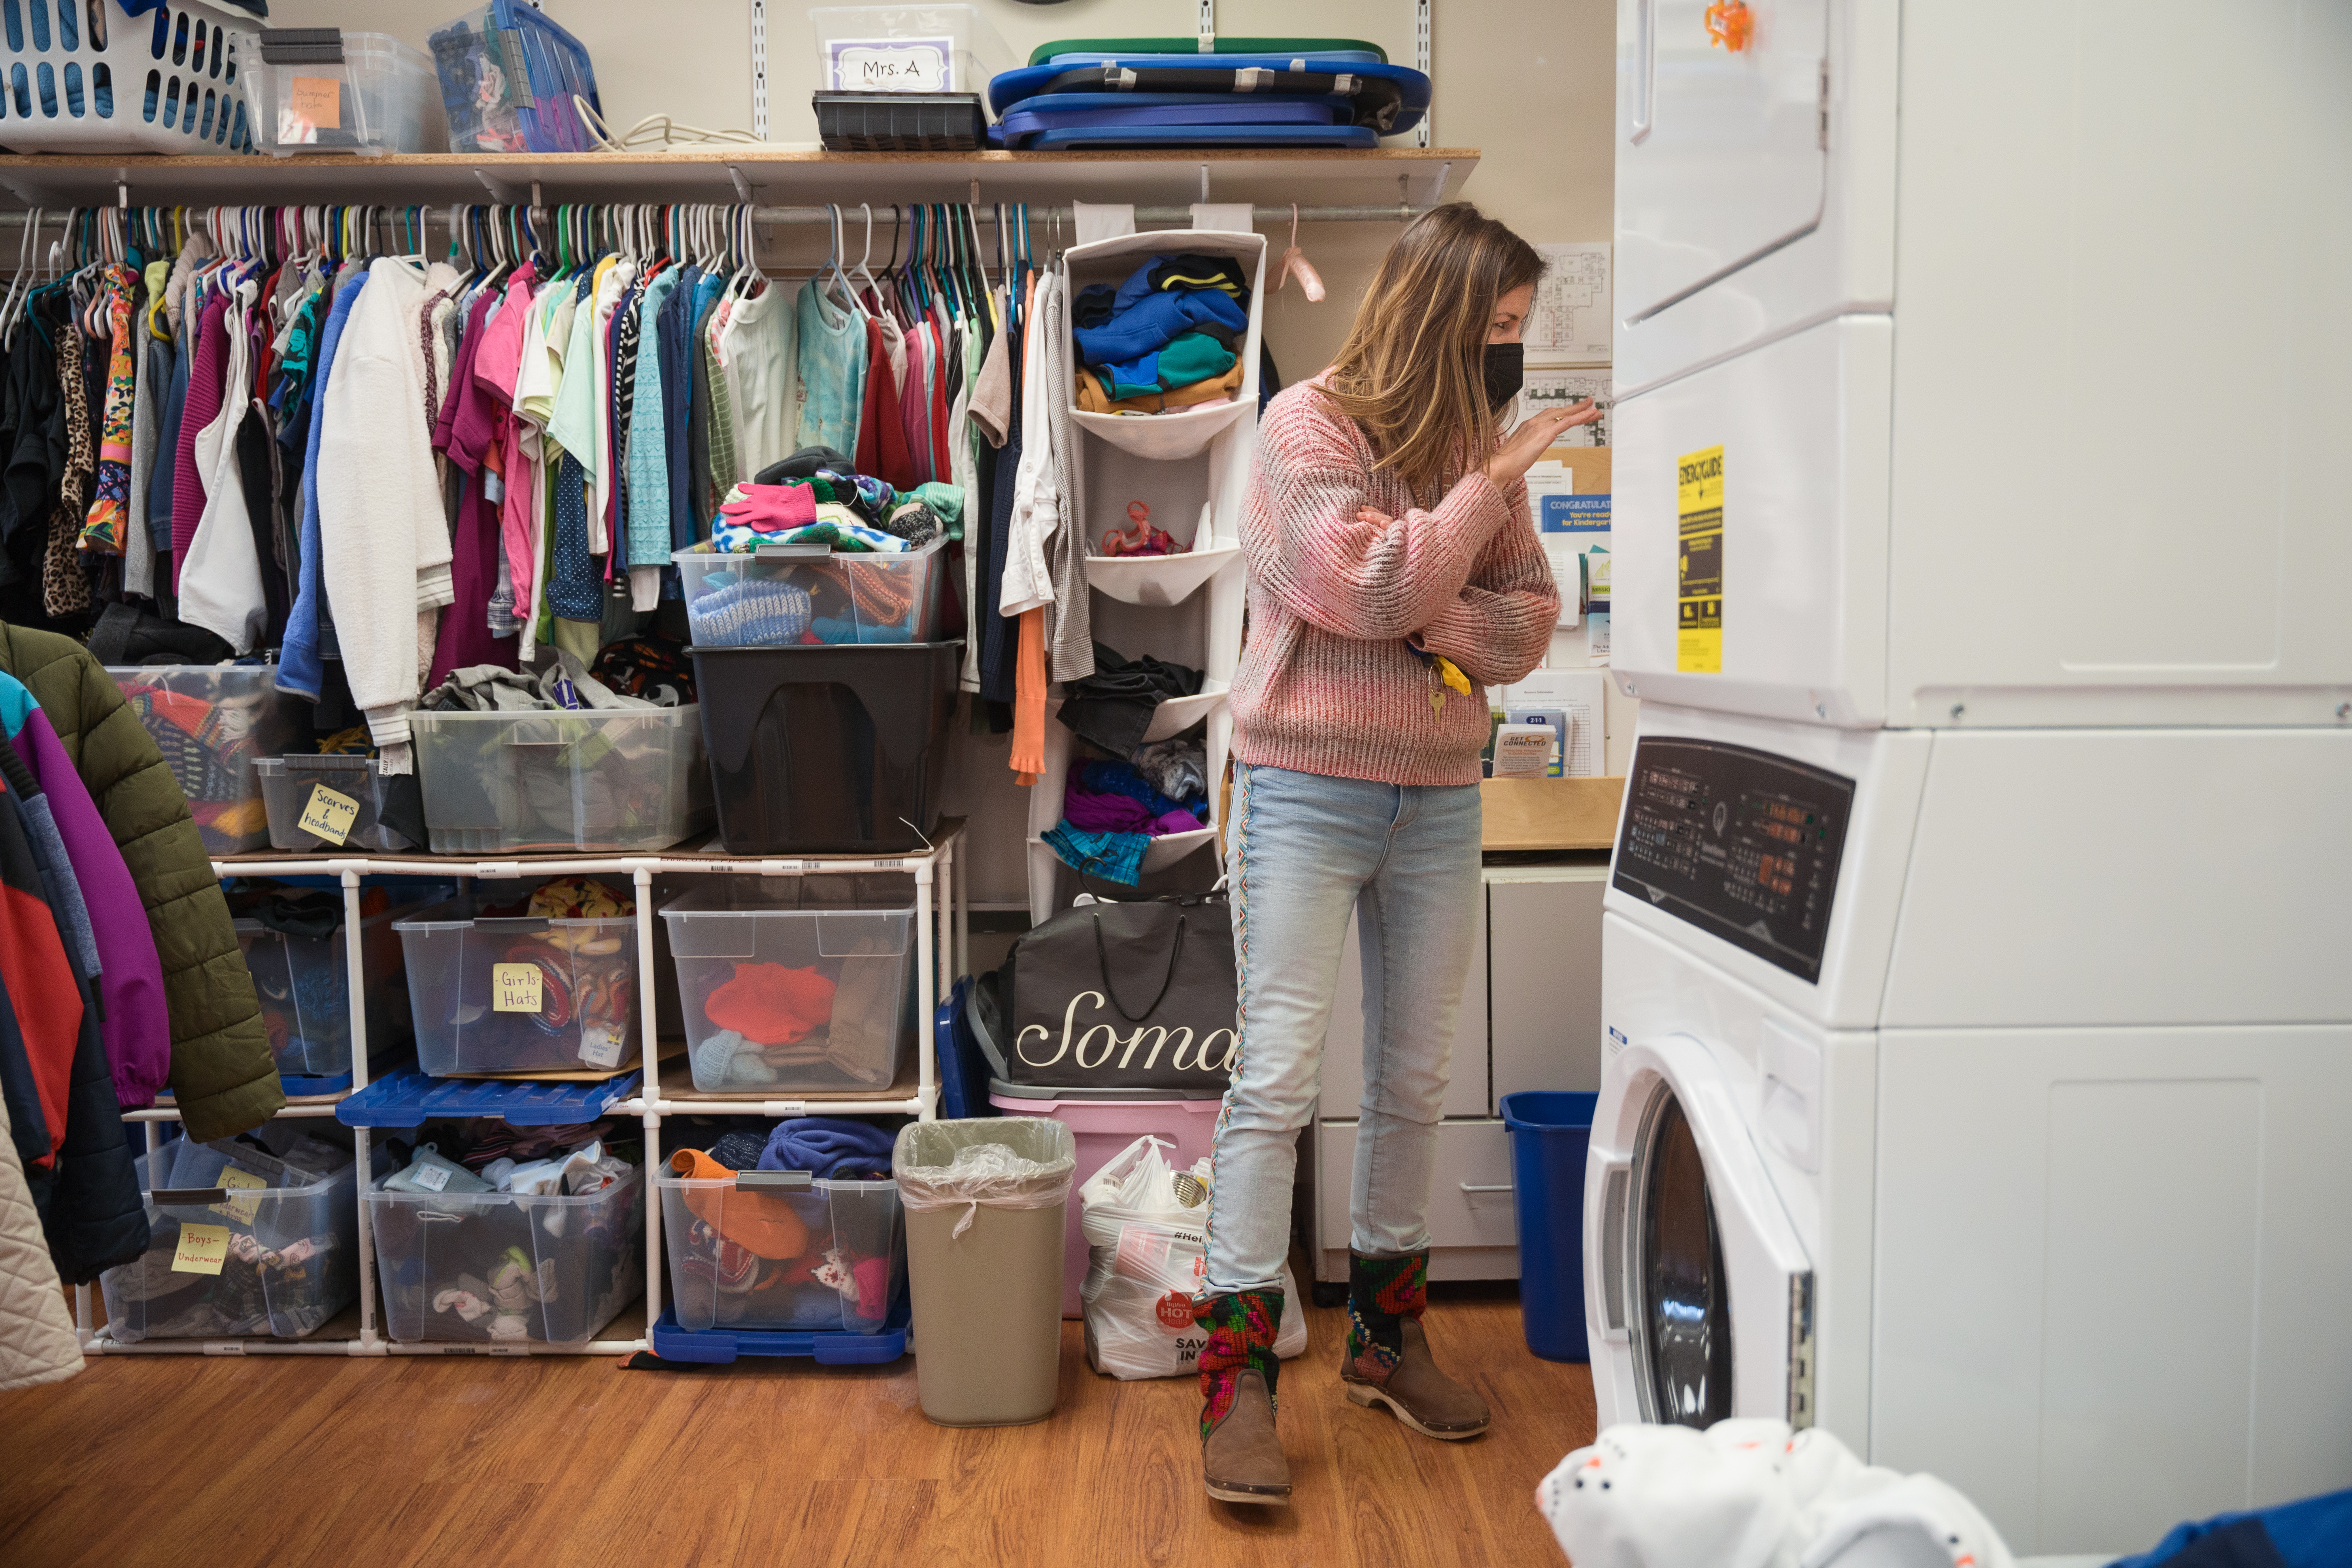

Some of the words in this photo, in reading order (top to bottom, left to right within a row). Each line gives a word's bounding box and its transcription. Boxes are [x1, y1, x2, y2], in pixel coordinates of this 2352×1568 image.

[864, 61, 899, 77] Mrs.
[904, 60, 920, 77] A
[317, 789, 355, 815] Scarves
[323, 808, 330, 820] &
[304, 812, 347, 840] headbands
[504, 990, 537, 1007] Hats
[1017, 991, 1238, 1072] Soma
[1174, 1231, 1204, 1245] #Hel
[178, 1252, 223, 1263] Underwear
[1161, 1307, 1192, 1319] HOT
[1175, 1338, 1207, 1349] SAV
[1180, 1351, 1196, 1360] IN
